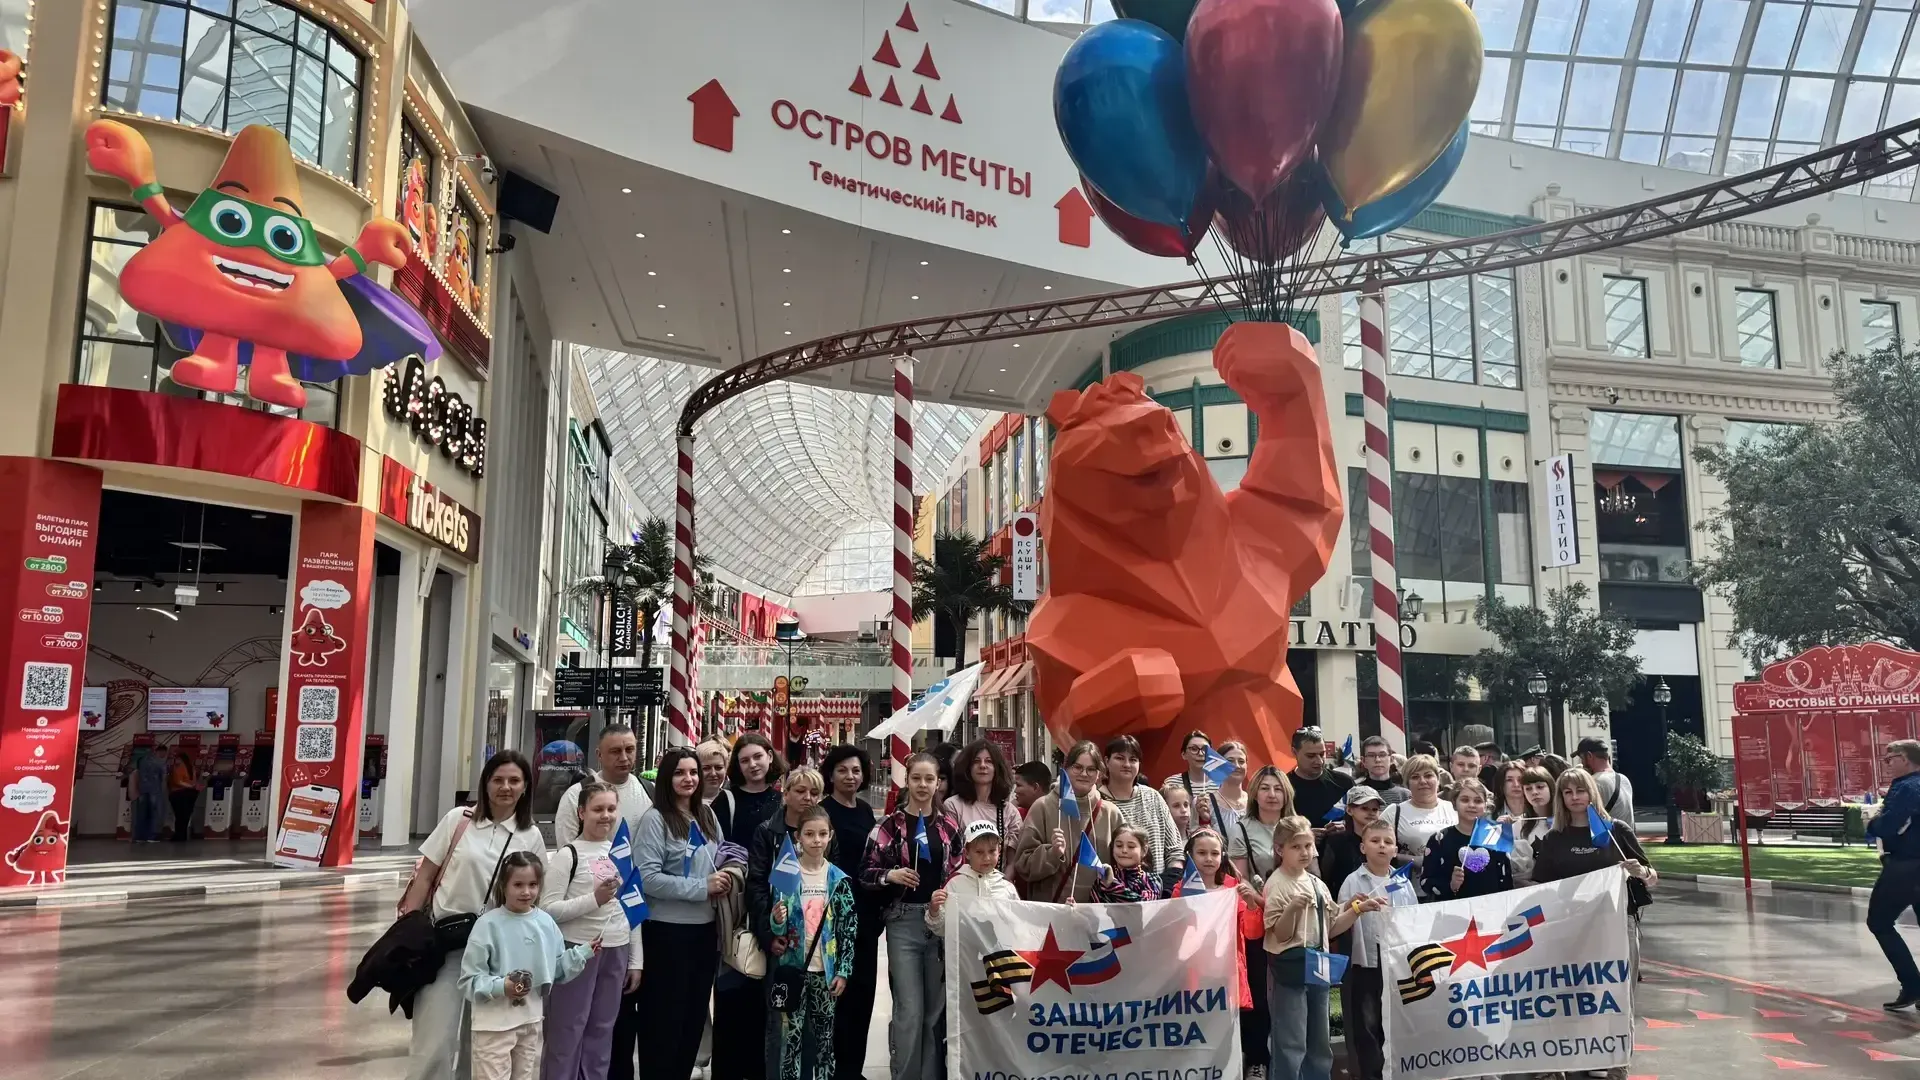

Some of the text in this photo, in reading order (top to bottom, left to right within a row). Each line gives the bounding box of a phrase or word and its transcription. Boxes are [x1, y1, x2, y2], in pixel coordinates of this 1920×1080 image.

[771, 99, 1031, 198] ОСТРОВ МЕЧТЫ
[809, 160, 998, 228] Тематический Парк
[70, 519, 89, 527] ПАРК
[409, 475, 469, 553] tickets
[35, 523, 89, 538] ВЫГОДНЕЕ
[1555, 494, 1570, 562] ПАТИО
[39, 534, 82, 548] ОНЛАЙН
[40, 563, 62, 572] 2800
[303, 557, 354, 567] РАЗВЛЕЧЕНИЙ
[62, 589, 83, 598] 7900
[33, 613, 41, 621] 10
[56, 640, 77, 648] 7000
[1769, 697, 1836, 709] РОСТОВЫЕ
[1448, 958, 1629, 1004] ЗАЩИТНИКИ
[1028, 986, 1227, 1030] ЗАЩИТНИКИ
[1447, 990, 1621, 1029] ОТЕЧЕСТВА
[1027, 1021, 1207, 1055] ОТЕЧЕСТВА
[1401, 1034, 1630, 1073] МОСКОВСКАЯ ОБЛАСТ
